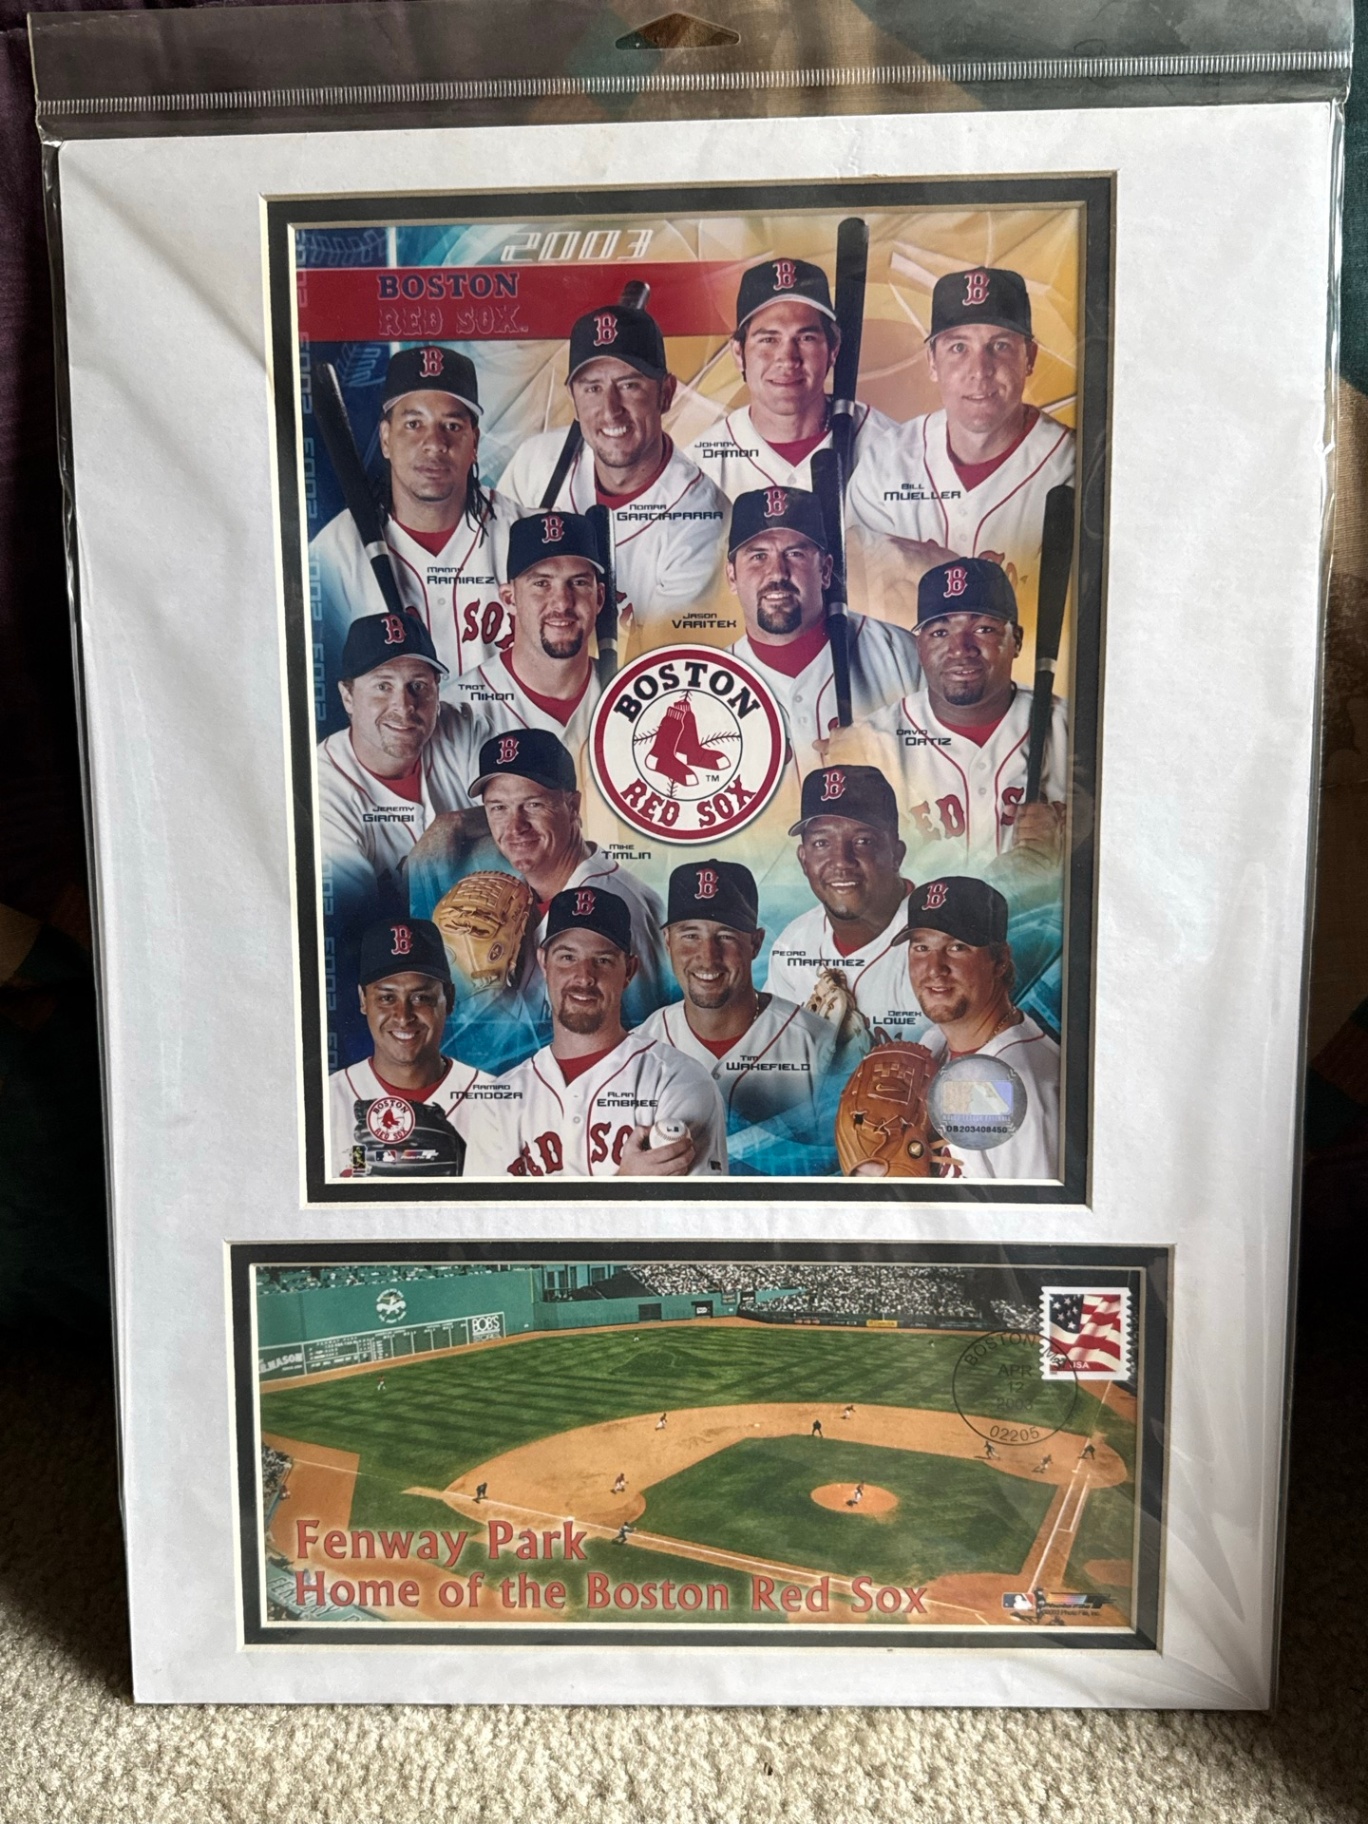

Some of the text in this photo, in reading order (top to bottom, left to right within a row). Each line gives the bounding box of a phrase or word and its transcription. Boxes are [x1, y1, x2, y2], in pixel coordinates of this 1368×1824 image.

[500, 229, 653, 262] 2003
[378, 273, 519, 300] BOSTON
[772, 258, 797, 291] B
[962, 270, 990, 306] B
[378, 305, 521, 336] RED SOX
[593, 312, 618, 347] B
[420, 346, 444, 377] B
[702, 448, 759, 458] DAMON
[763, 485, 788, 518] B
[884, 490, 961, 502] MUELLER
[541, 515, 565, 544] B
[426, 575, 496, 585] RAMIREZ
[943, 565, 968, 598] B
[381, 613, 407, 645] B
[613, 662, 761, 723] BOSTON
[497, 735, 519, 765] B
[905, 737, 952, 746] ORTIZ
[821, 770, 846, 801] B
[620, 774, 757, 828] RED SOX
[601, 850, 651, 860] TIMLIN
[694, 868, 719, 899] B
[922, 882, 946, 910] B
[571, 889, 596, 917] B
[390, 925, 413, 955] B
[787, 957, 865, 967] MARTINEZ
[873, 1016, 916, 1025] LOWE
[726, 1062, 811, 1072] WAKEFIELD
[372, 1100, 409, 1115] BOSTON
[450, 1090, 523, 1100] MENDOZA
[597, 1099, 658, 1107] EMBREE
[374, 1128, 408, 1140] RED SOX
[964, 1333, 1036, 1367] BOSTON
[998, 1364, 1033, 1377] APR
[1008, 1381, 1024, 1394] 12
[989, 1425, 1040, 1442] 02205
[295, 1519, 587, 1568] Fenway Park
[295, 1571, 928, 1614] Home of the Boston Red Sox
